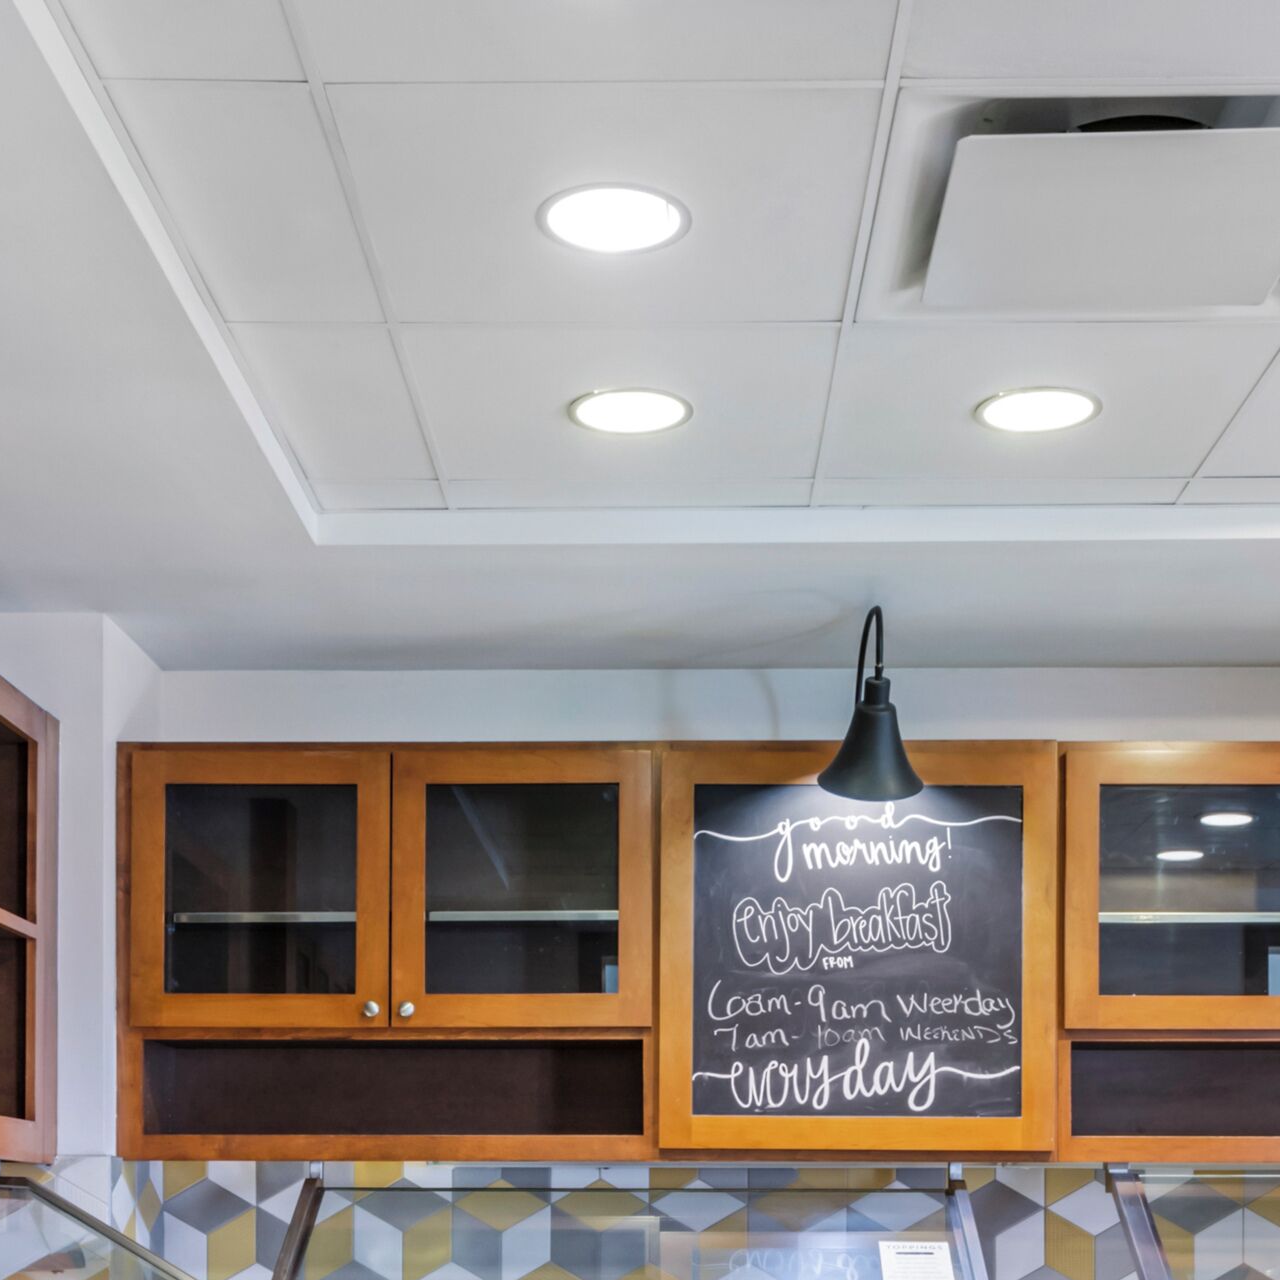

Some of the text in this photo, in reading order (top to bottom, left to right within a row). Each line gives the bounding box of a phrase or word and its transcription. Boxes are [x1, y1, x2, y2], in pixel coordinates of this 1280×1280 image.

[774, 801, 898, 882] good
[803, 827, 952, 871] morning!
[736, 889, 949, 963] enjoy breakfast
[822, 955, 854, 971] FROM
